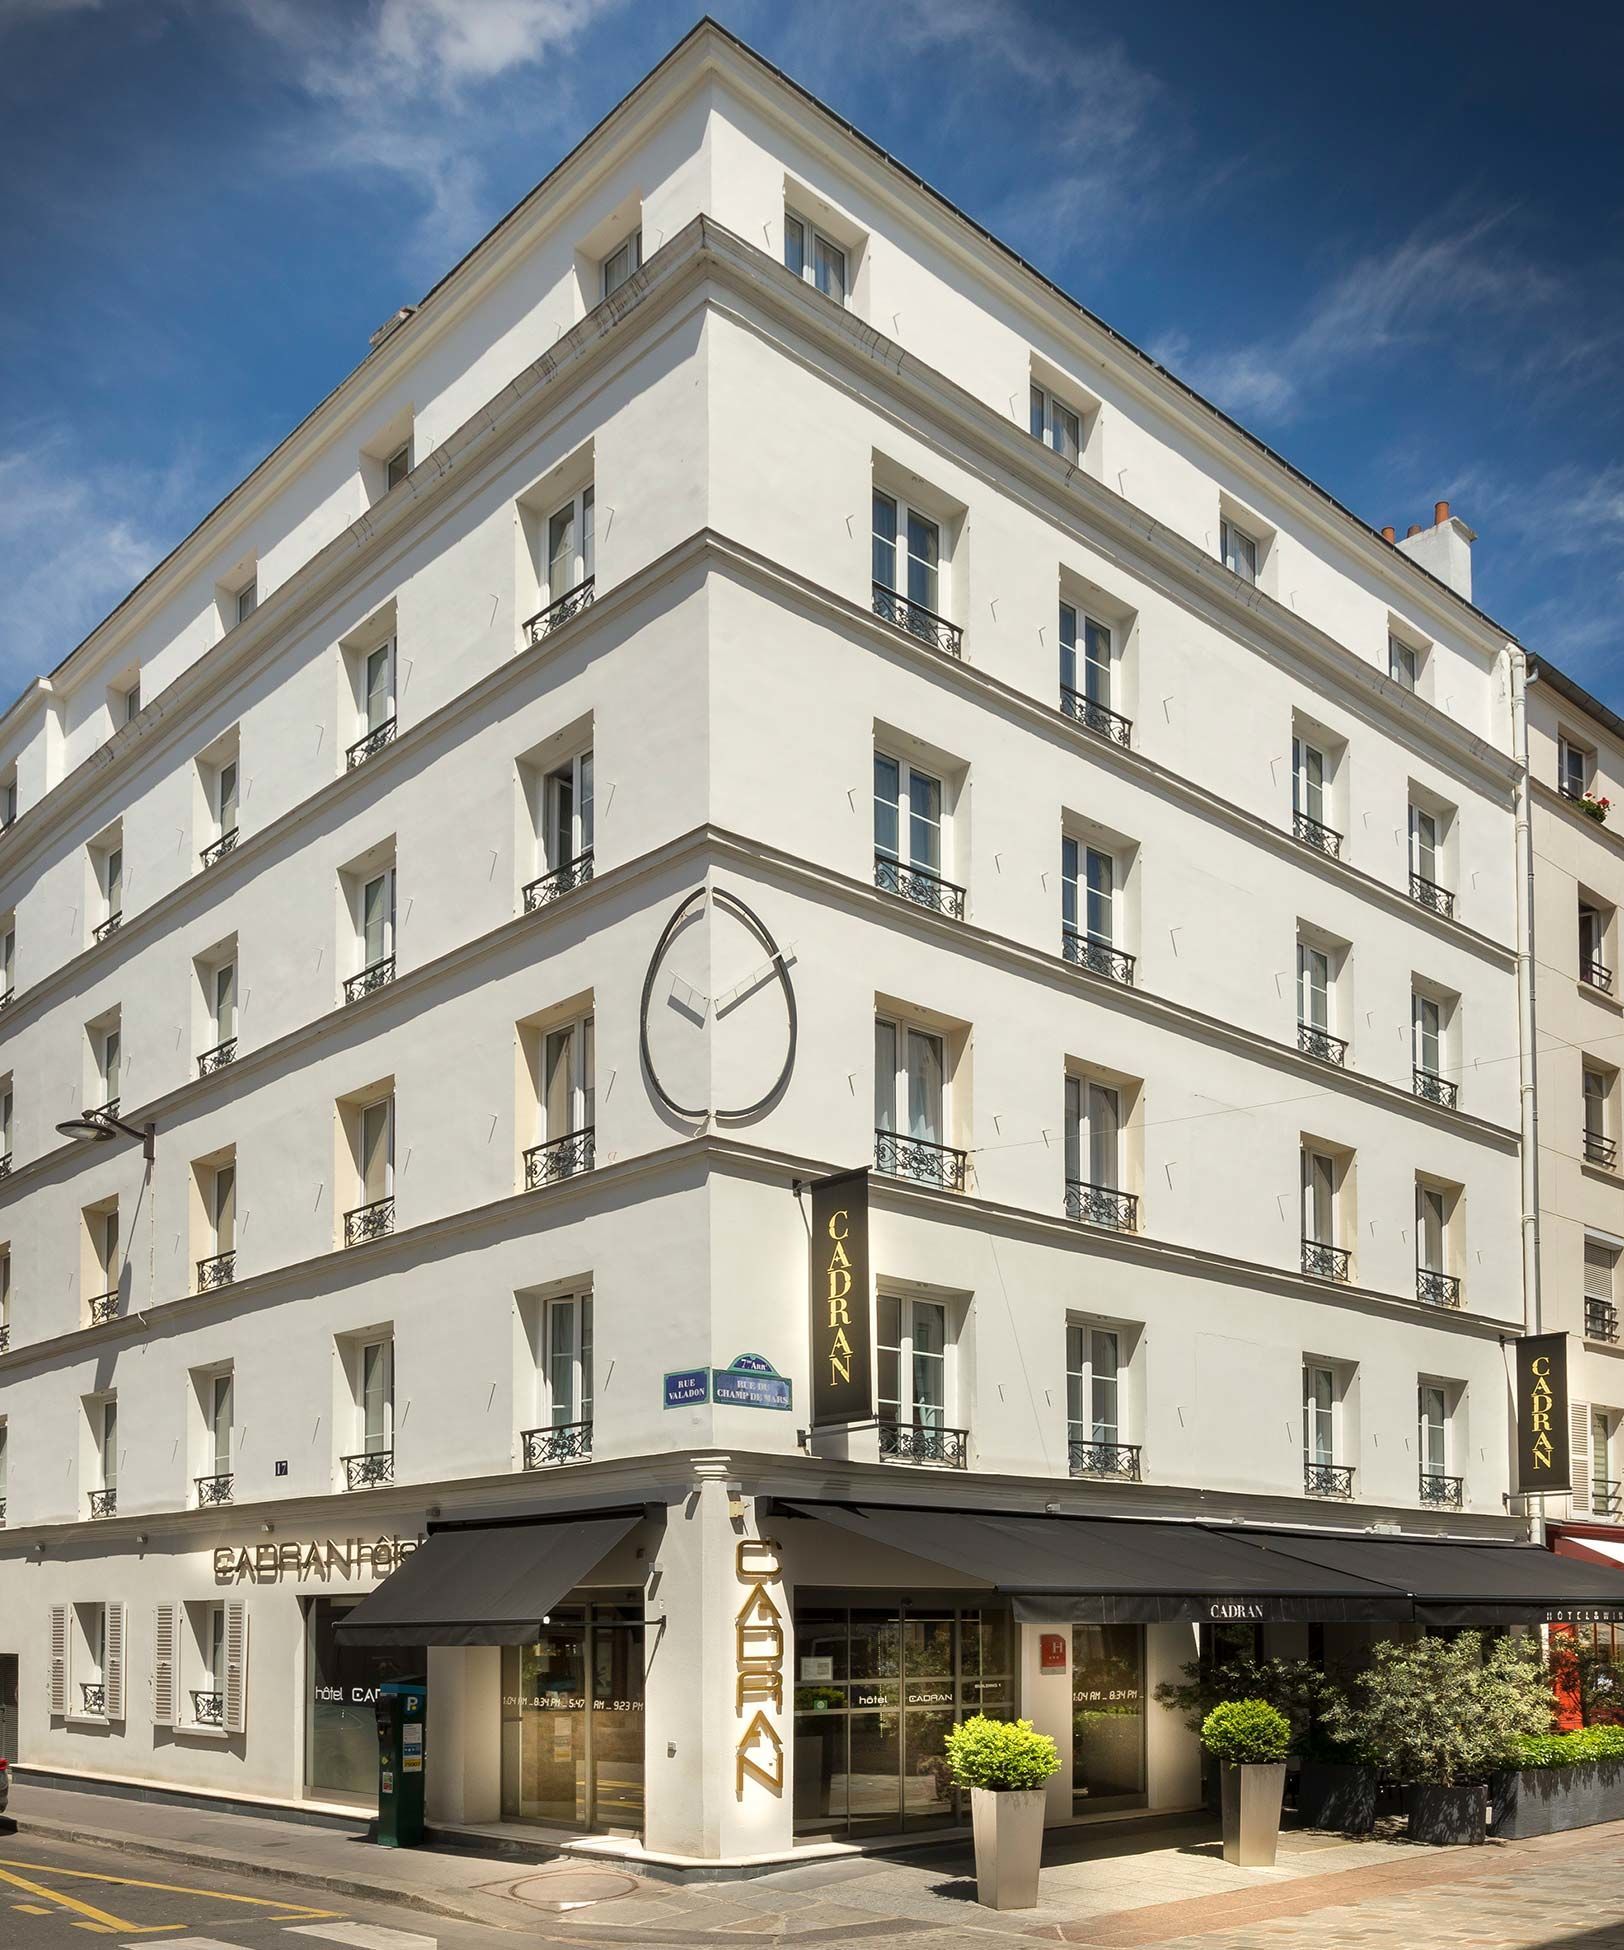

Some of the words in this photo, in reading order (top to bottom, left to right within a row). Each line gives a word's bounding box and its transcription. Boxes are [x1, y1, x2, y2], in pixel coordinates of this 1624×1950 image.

[827, 1210, 853, 1386] CADRAN
[678, 1378, 696, 1389] RUE
[737, 1380, 756, 1391] RUE
[757, 1381, 769, 1391] DU
[668, 1387, 705, 1400] VALADON
[717, 1389, 750, 1401] CHAMP
[750, 1392, 762, 1402] DE
[763, 1393, 788, 1404] MARS
[1531, 1356, 1554, 1470] CADRAN
[277, 1462, 287, 1475] 17
[213, 1538, 354, 1574] CADRAN
[1210, 1604, 1263, 1618] CADRAN
[1053, 1641, 1063, 1653] H
[736, 1539, 783, 1793] CADRAN
[315, 1685, 344, 1701] hôtel
[859, 1695, 888, 1705] hôtel
[908, 1693, 953, 1703] CADRAN
[1089, 1691, 1101, 1701] AM
[1127, 1689, 1138, 1699] PM
[407, 1696, 419, 1711] P
[593, 1700, 605, 1710] AM
[632, 1701, 644, 1711] PM
